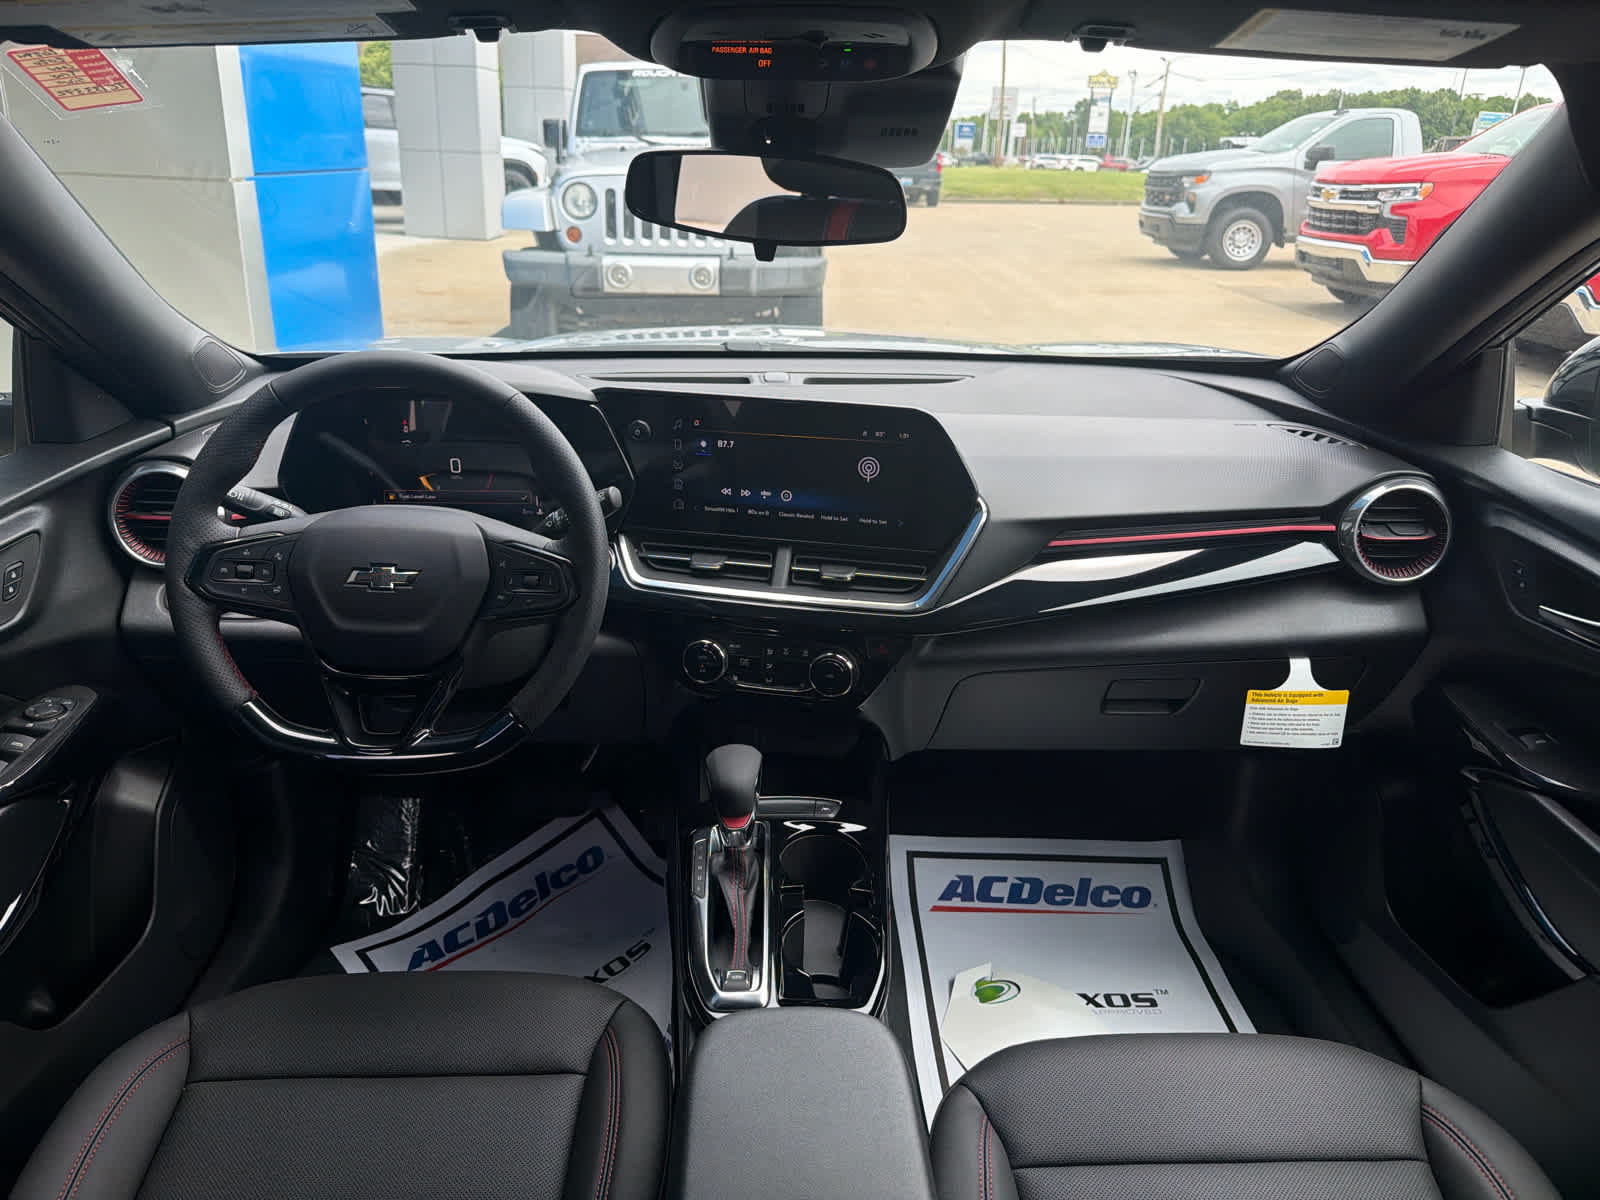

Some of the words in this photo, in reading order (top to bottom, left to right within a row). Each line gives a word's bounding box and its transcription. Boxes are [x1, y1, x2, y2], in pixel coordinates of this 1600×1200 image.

[711, 46, 747, 54] PASSENGER
[760, 47, 773, 55] BAG
[757, 60, 773, 69] OFF
[717, 439, 735, 449] 87.7
[450, 458, 462, 473] 0
[936, 874, 1152, 909] ACDelco
[407, 845, 605, 972] ACDelco
[1075, 992, 1159, 1009] XOS
